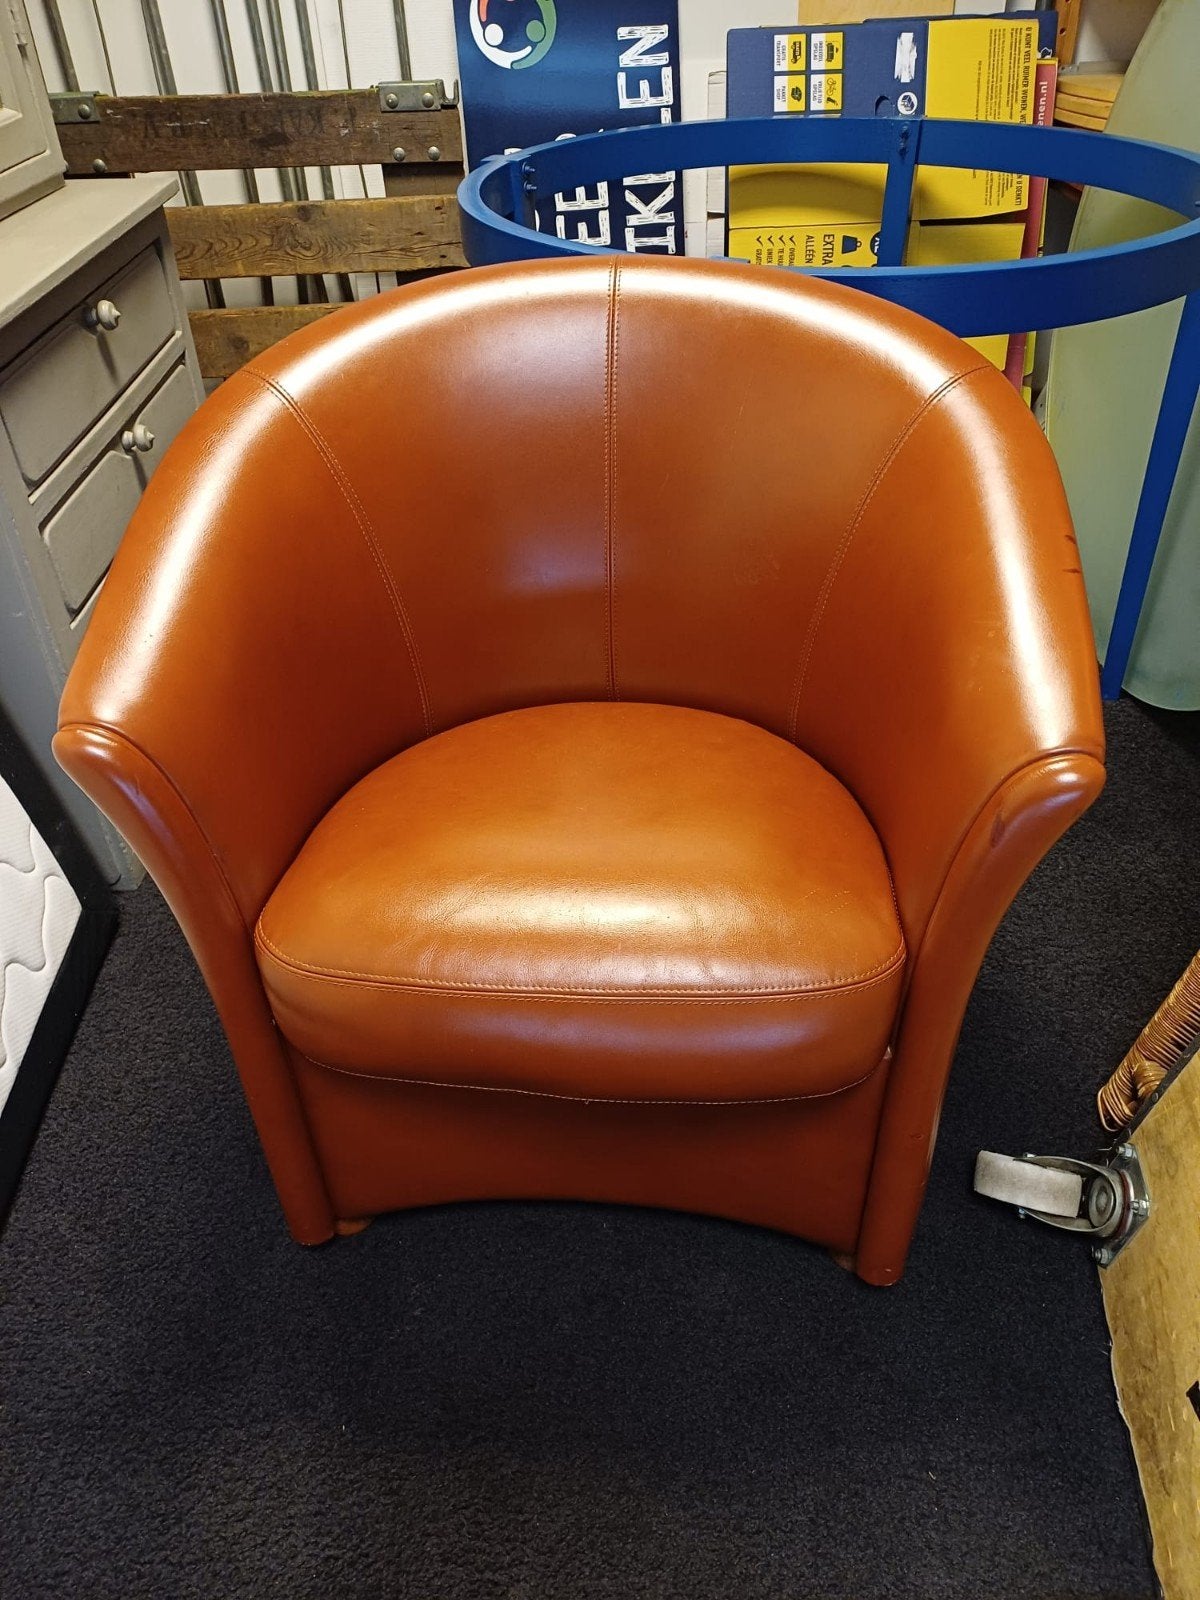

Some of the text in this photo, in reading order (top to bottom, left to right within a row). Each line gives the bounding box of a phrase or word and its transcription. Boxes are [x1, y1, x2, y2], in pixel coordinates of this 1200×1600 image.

[1024, 33, 1032, 49] KUNT
[1023, 50, 1031, 64] VEEL
[805, 235, 815, 264] ALLÉÉN
[822, 234, 834, 265] EXTRA
